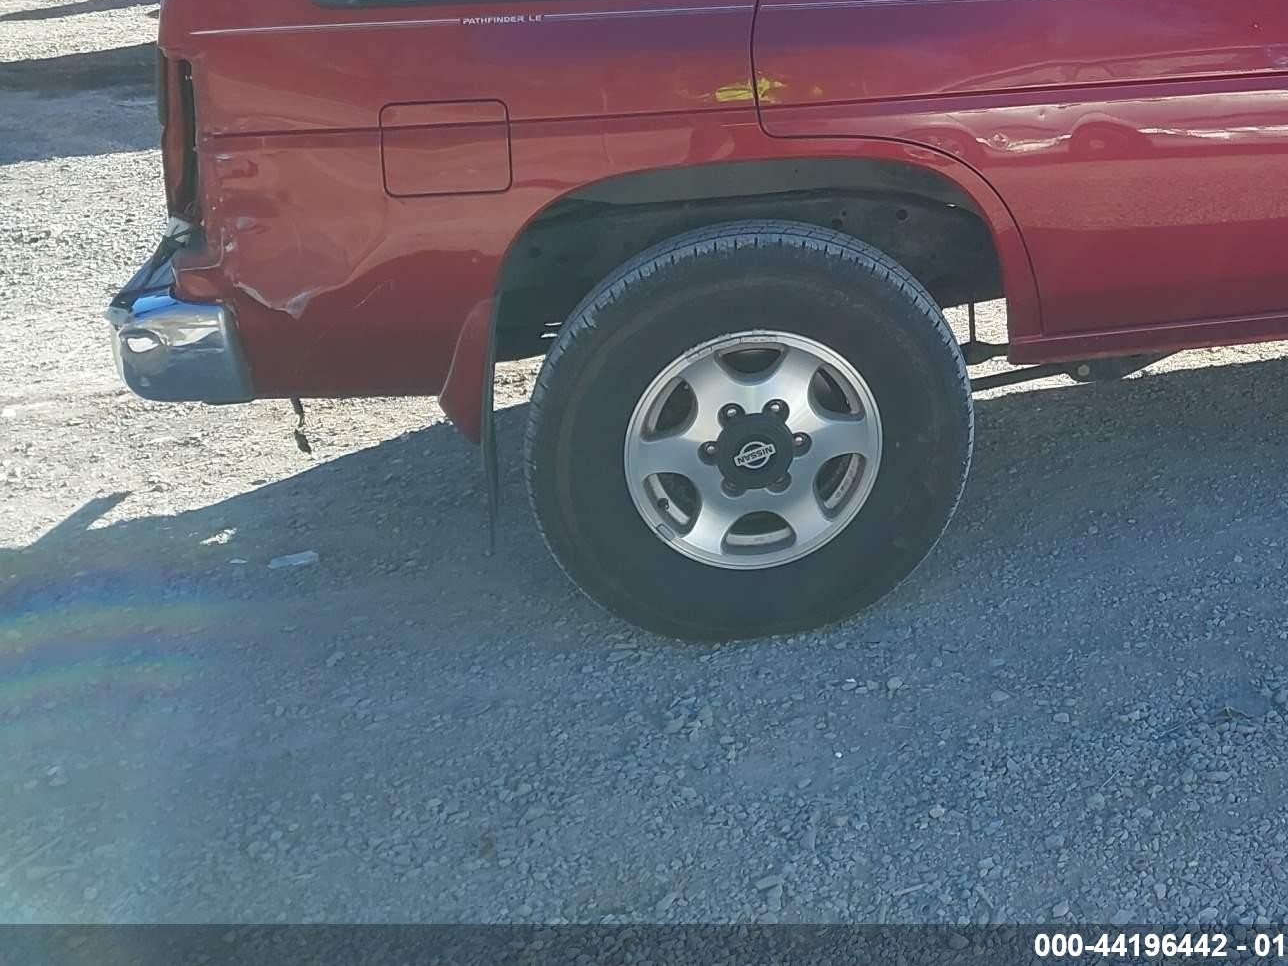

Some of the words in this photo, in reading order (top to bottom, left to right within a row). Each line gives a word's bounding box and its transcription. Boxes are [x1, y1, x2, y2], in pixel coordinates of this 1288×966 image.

[462, 15, 525, 25] PATHFINDER
[528, 14, 542, 22] LE
[737, 443, 773, 462] NISSAN
